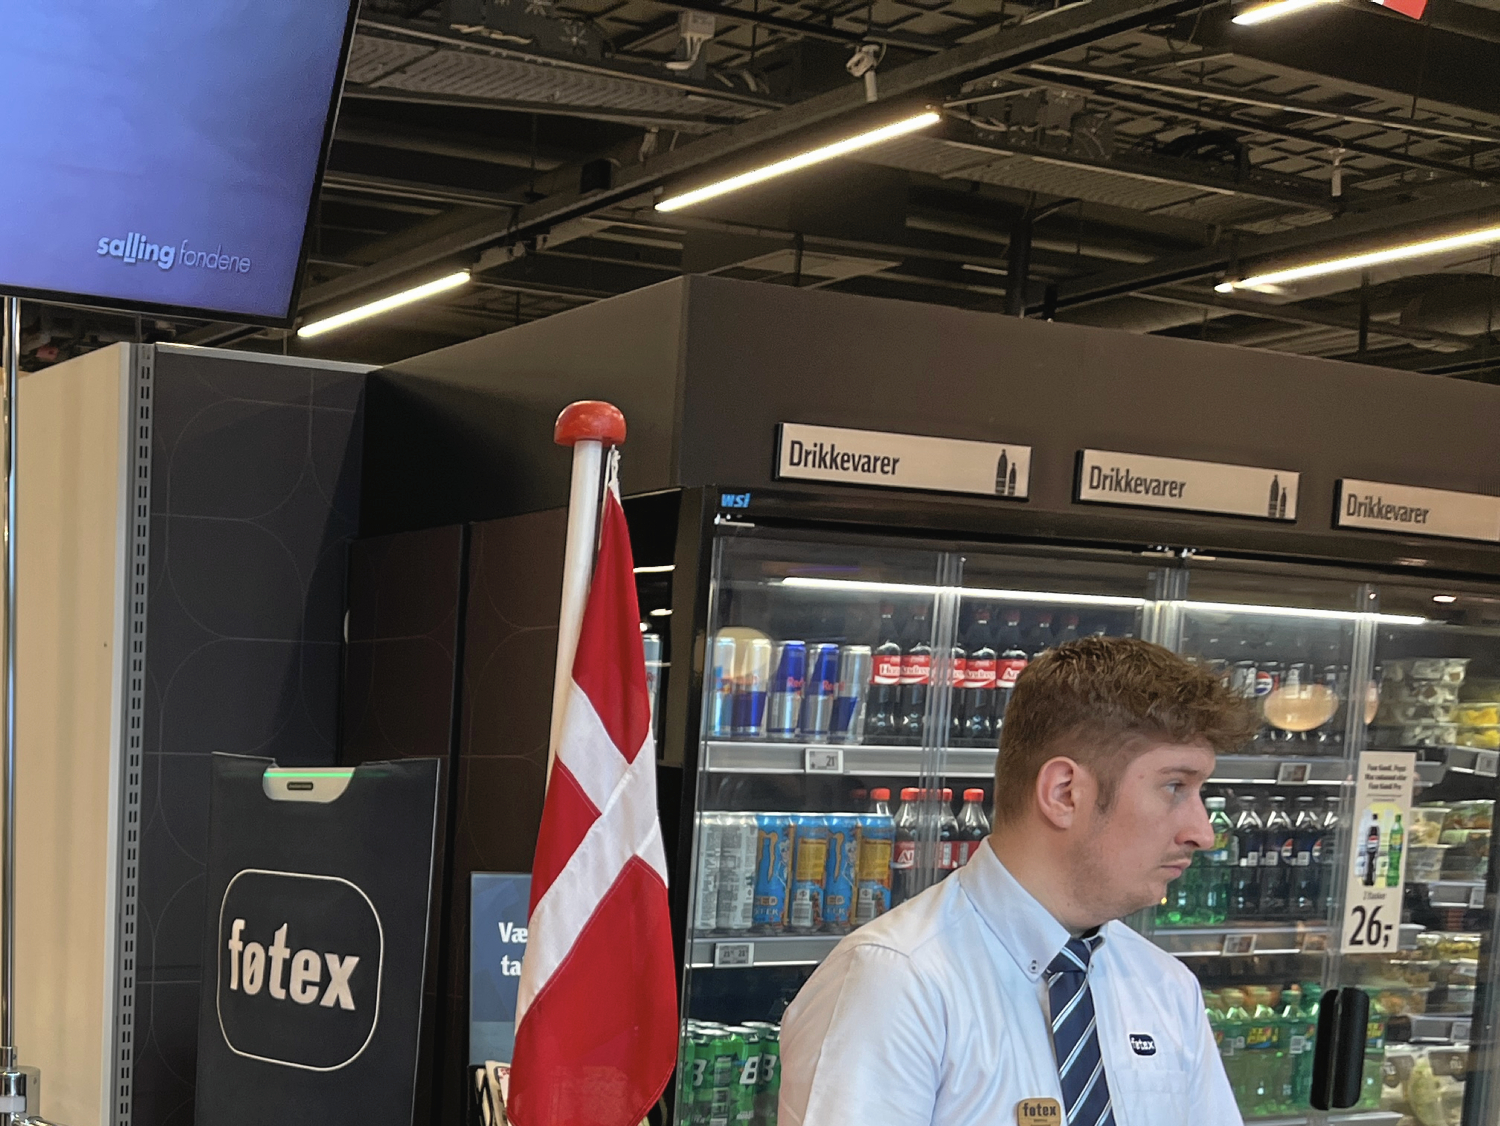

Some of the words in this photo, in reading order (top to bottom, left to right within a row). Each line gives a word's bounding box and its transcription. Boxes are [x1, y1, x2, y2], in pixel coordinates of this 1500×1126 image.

[96, 232, 176, 270] salling
[178, 239, 251, 273] fondene
[789, 439, 900, 476] Drikkevarer
[1088, 465, 1186, 499] Drikkevarer
[1346, 493, 1430, 524] Drikkevarer
[498, 922, 528, 943] Væ
[228, 918, 360, 1011] føtex
[500, 955, 524, 976] ta
